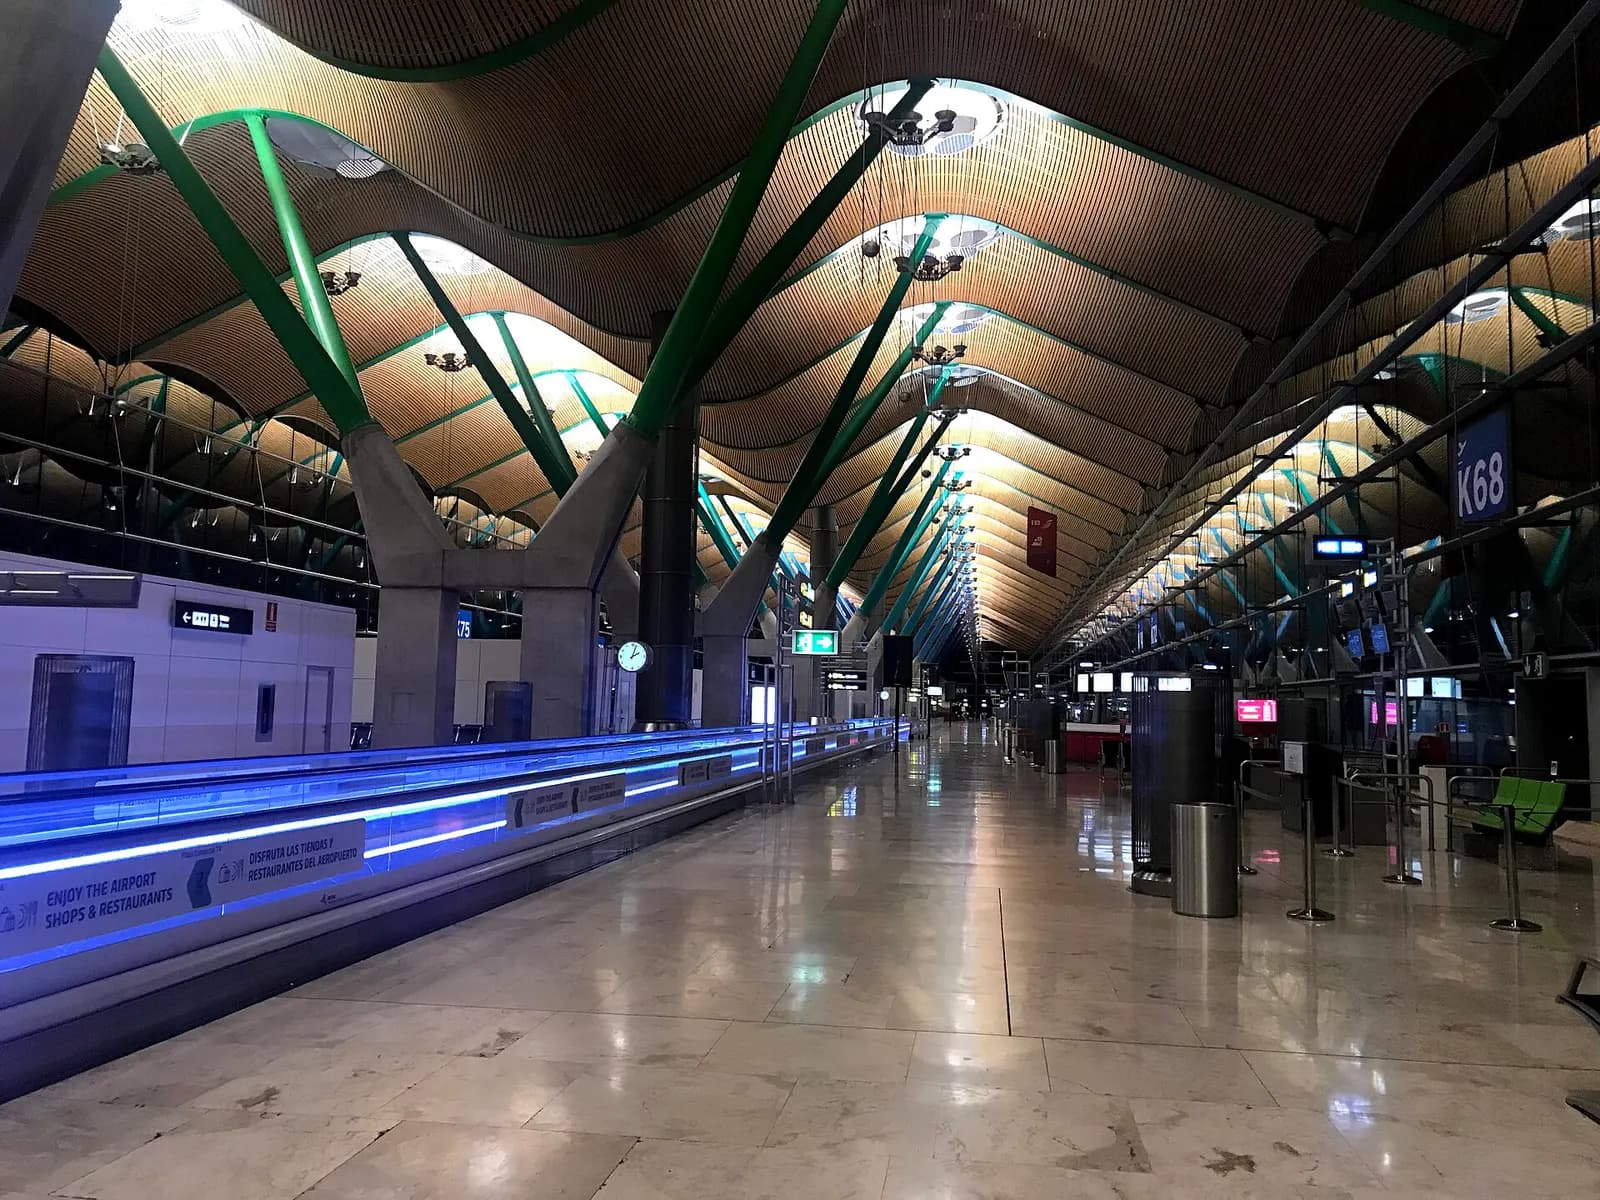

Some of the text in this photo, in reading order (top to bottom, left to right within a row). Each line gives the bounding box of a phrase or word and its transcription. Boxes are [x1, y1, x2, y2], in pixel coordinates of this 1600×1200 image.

[1458, 451, 1504, 518] K68
[248, 847, 358, 882] RESTAURANTES DEL AEROPUERTO
[249, 837, 335, 865] DISFRUTA LAS TIENDAS Y
[47, 872, 157, 907] ENJOY THE AIRPORT
[45, 887, 173, 929] SHOPS & RESTAURANTS
